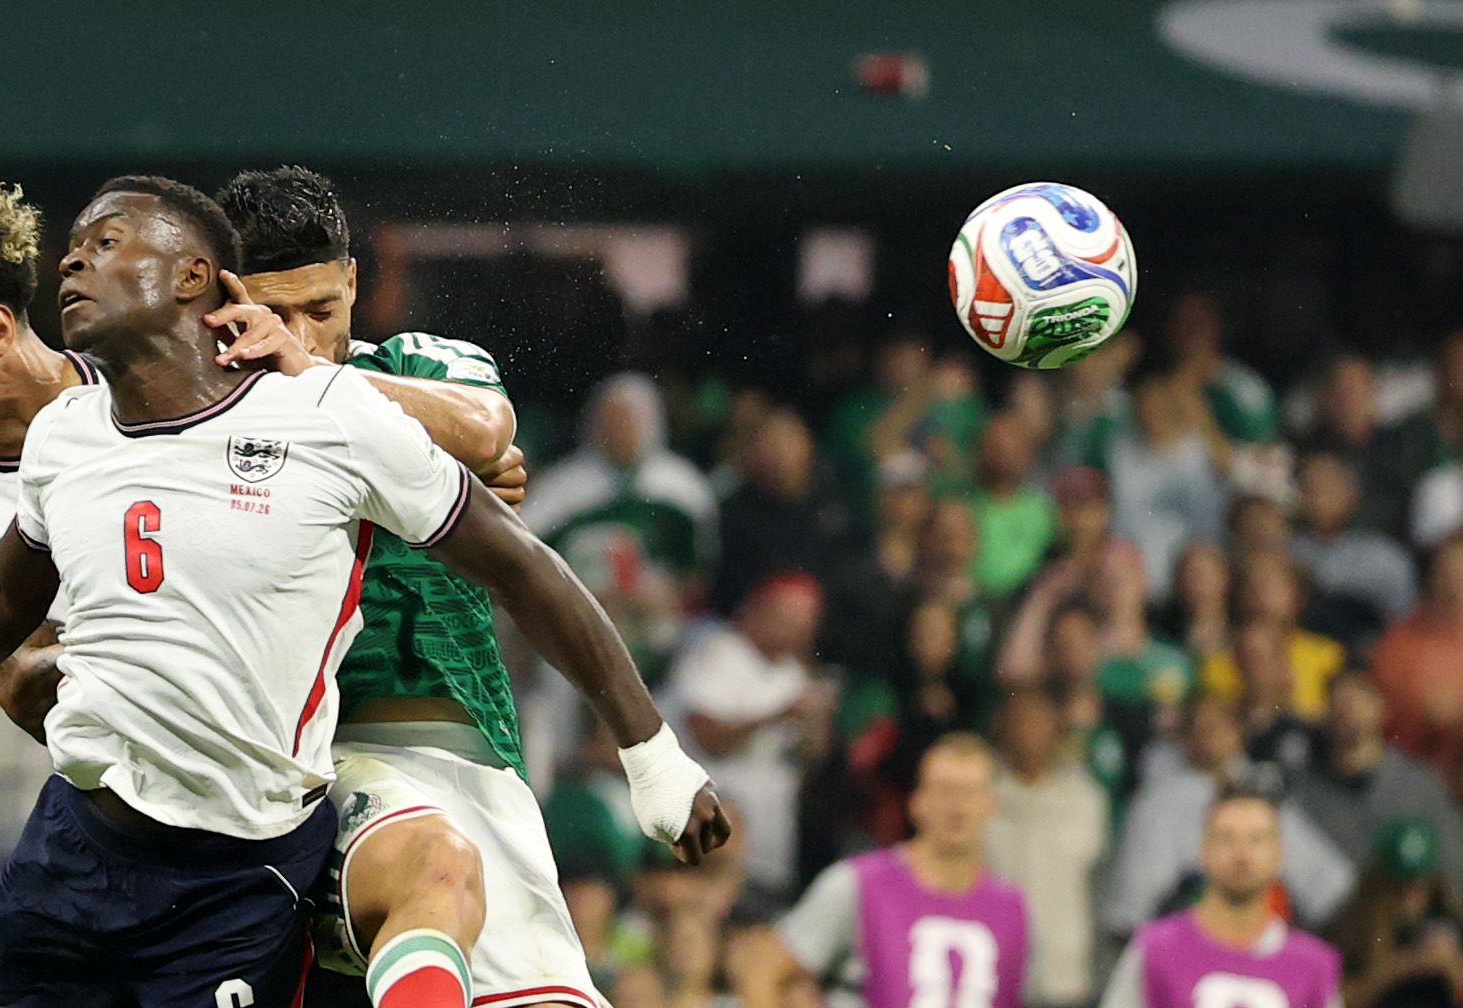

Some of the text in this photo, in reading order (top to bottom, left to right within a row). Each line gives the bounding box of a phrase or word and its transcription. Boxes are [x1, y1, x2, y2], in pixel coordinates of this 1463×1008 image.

[230, 484, 271, 498] MEXICO
[230, 499, 271, 515] 05.07.26
[124, 500, 165, 594] 6
